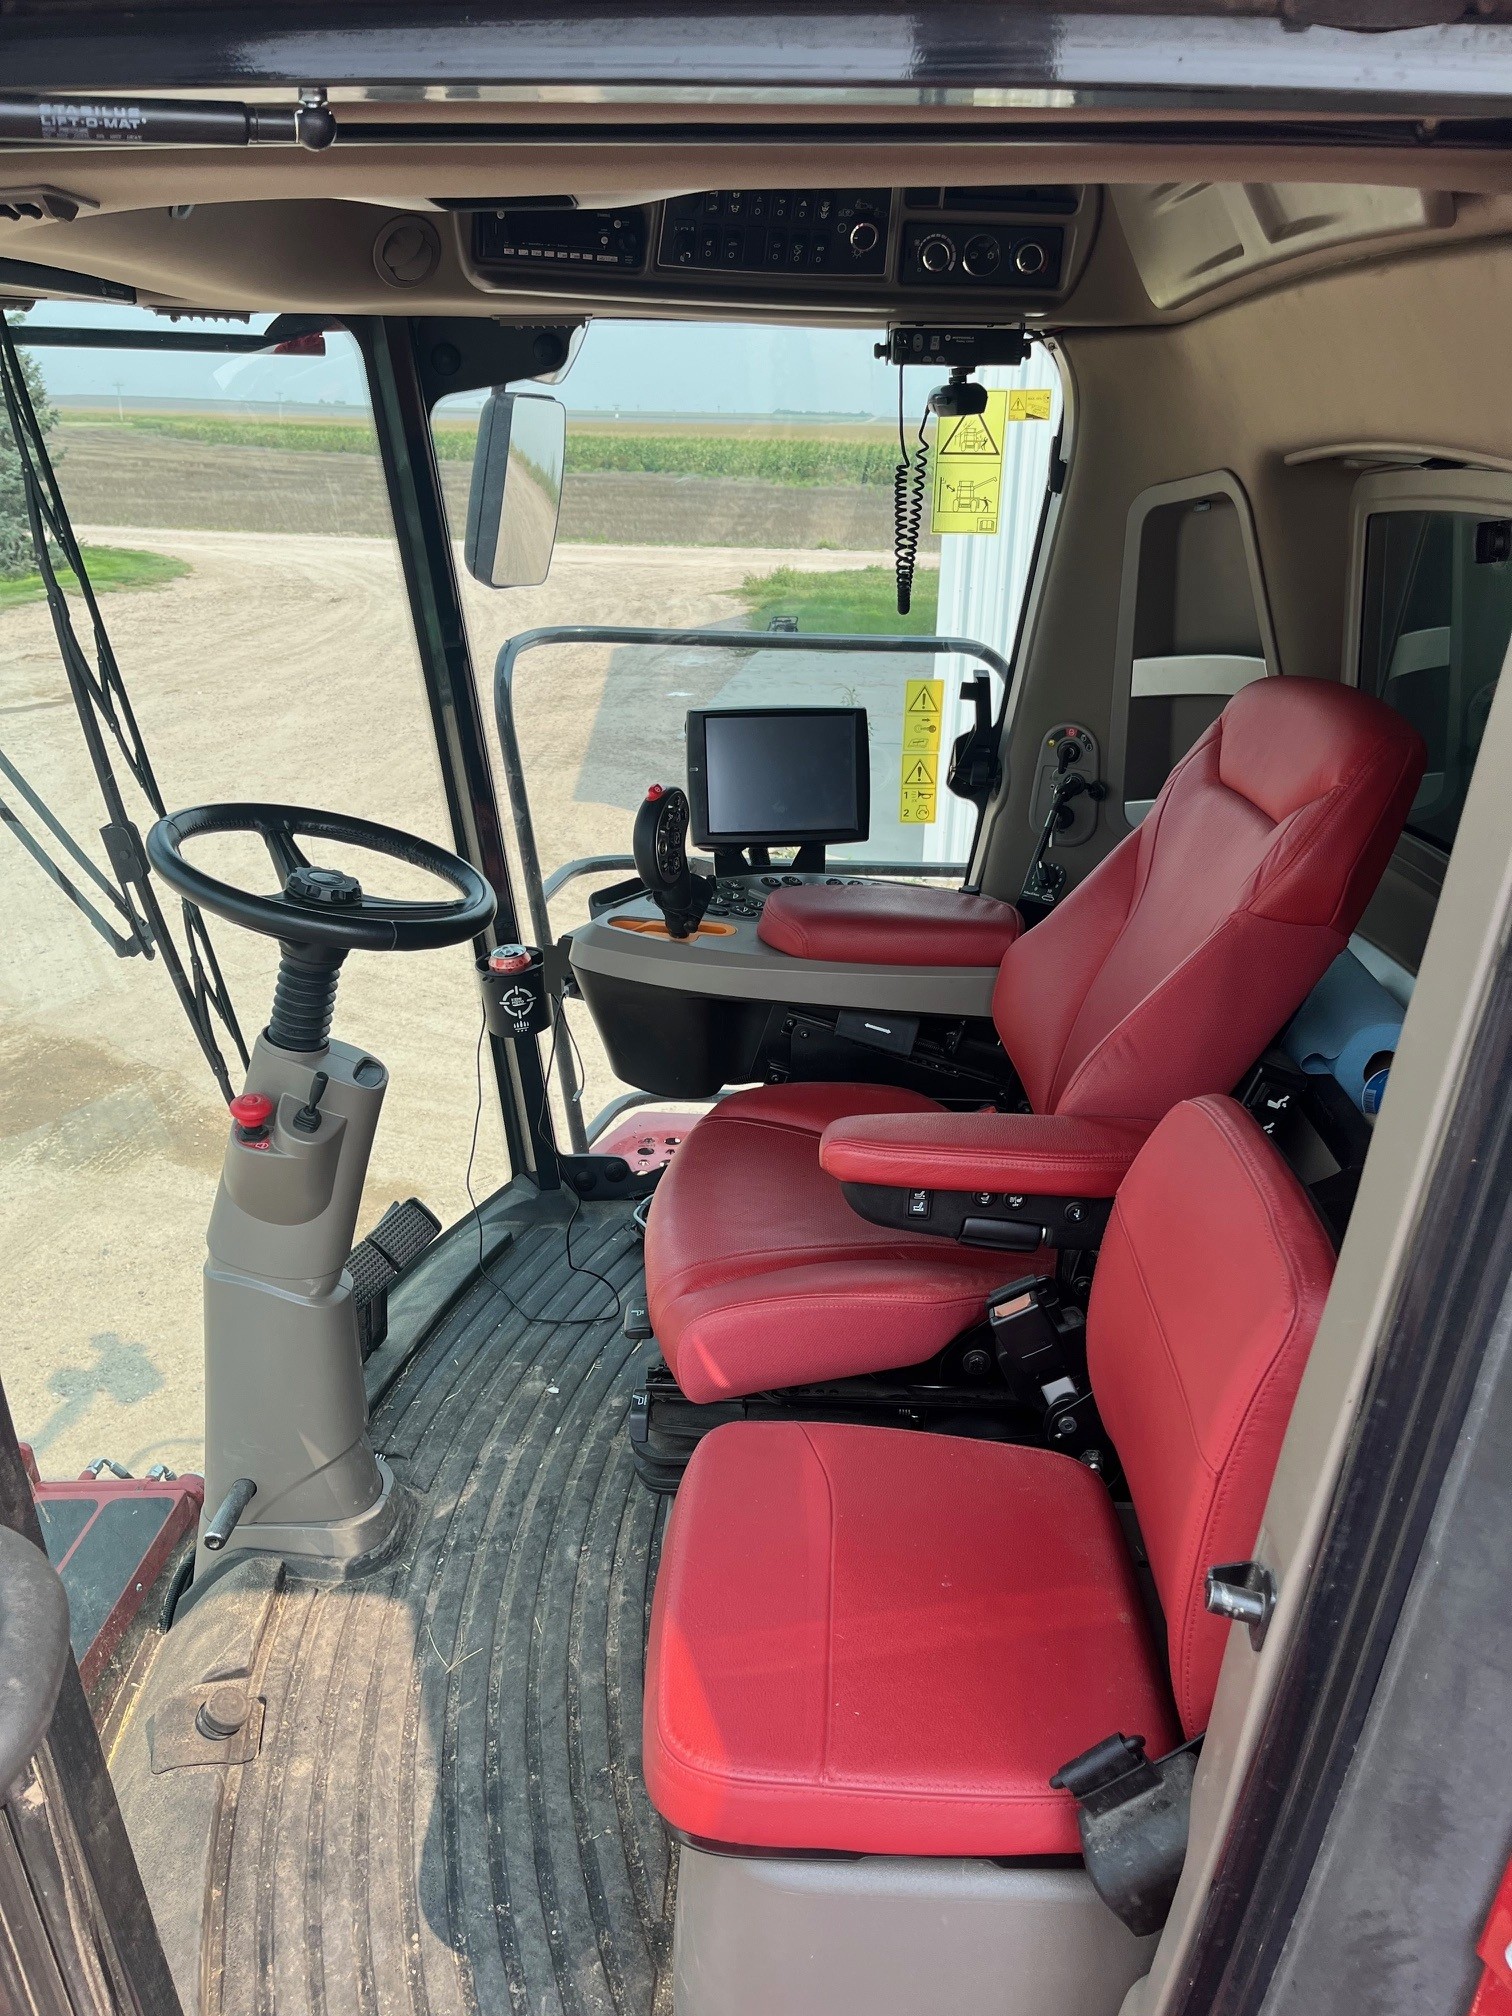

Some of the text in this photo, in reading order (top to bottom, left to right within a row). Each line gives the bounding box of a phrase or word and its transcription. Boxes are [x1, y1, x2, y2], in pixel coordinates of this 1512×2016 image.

[38, 104, 141, 117] STABILUS
[903, 791, 908, 799] 1
[903, 809, 909, 817] 2
